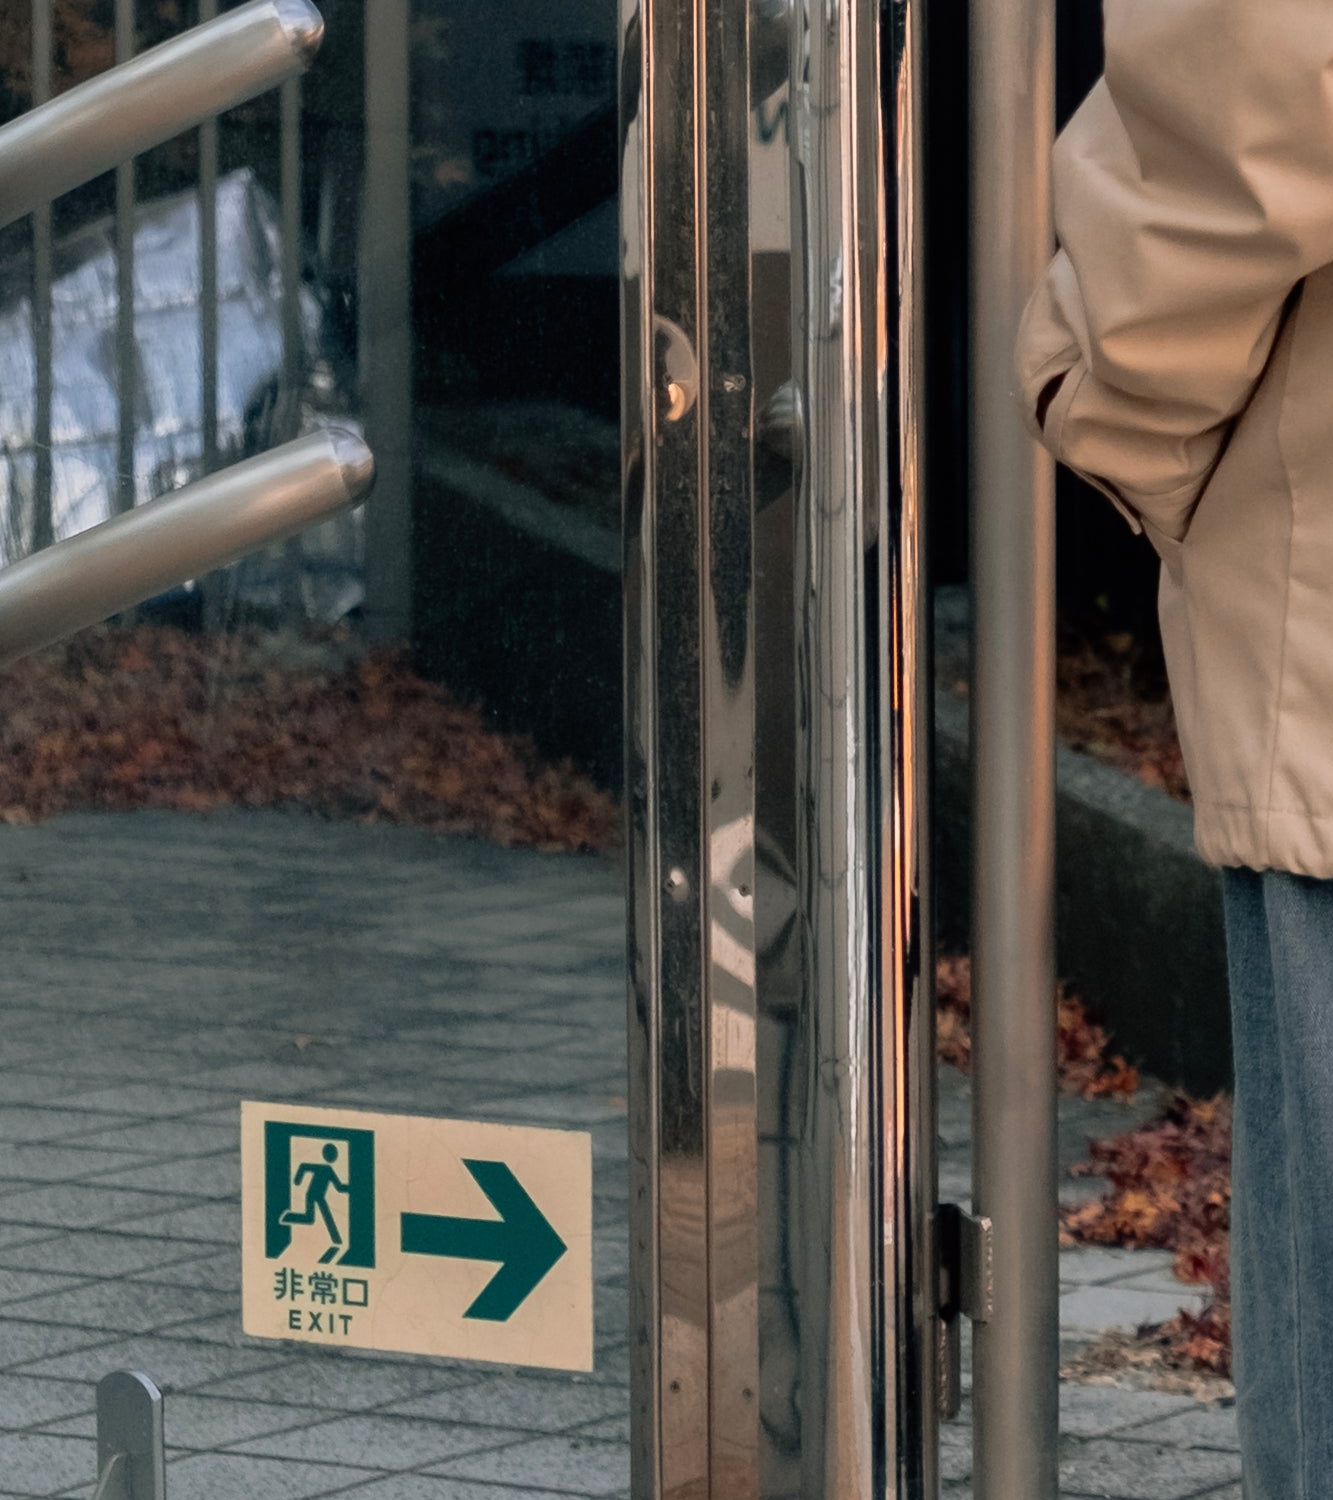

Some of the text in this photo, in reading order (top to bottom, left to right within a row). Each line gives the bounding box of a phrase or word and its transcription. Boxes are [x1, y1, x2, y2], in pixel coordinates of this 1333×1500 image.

[273, 1267, 369, 1308] 非常口
[288, 1309, 353, 1336] EXIT
